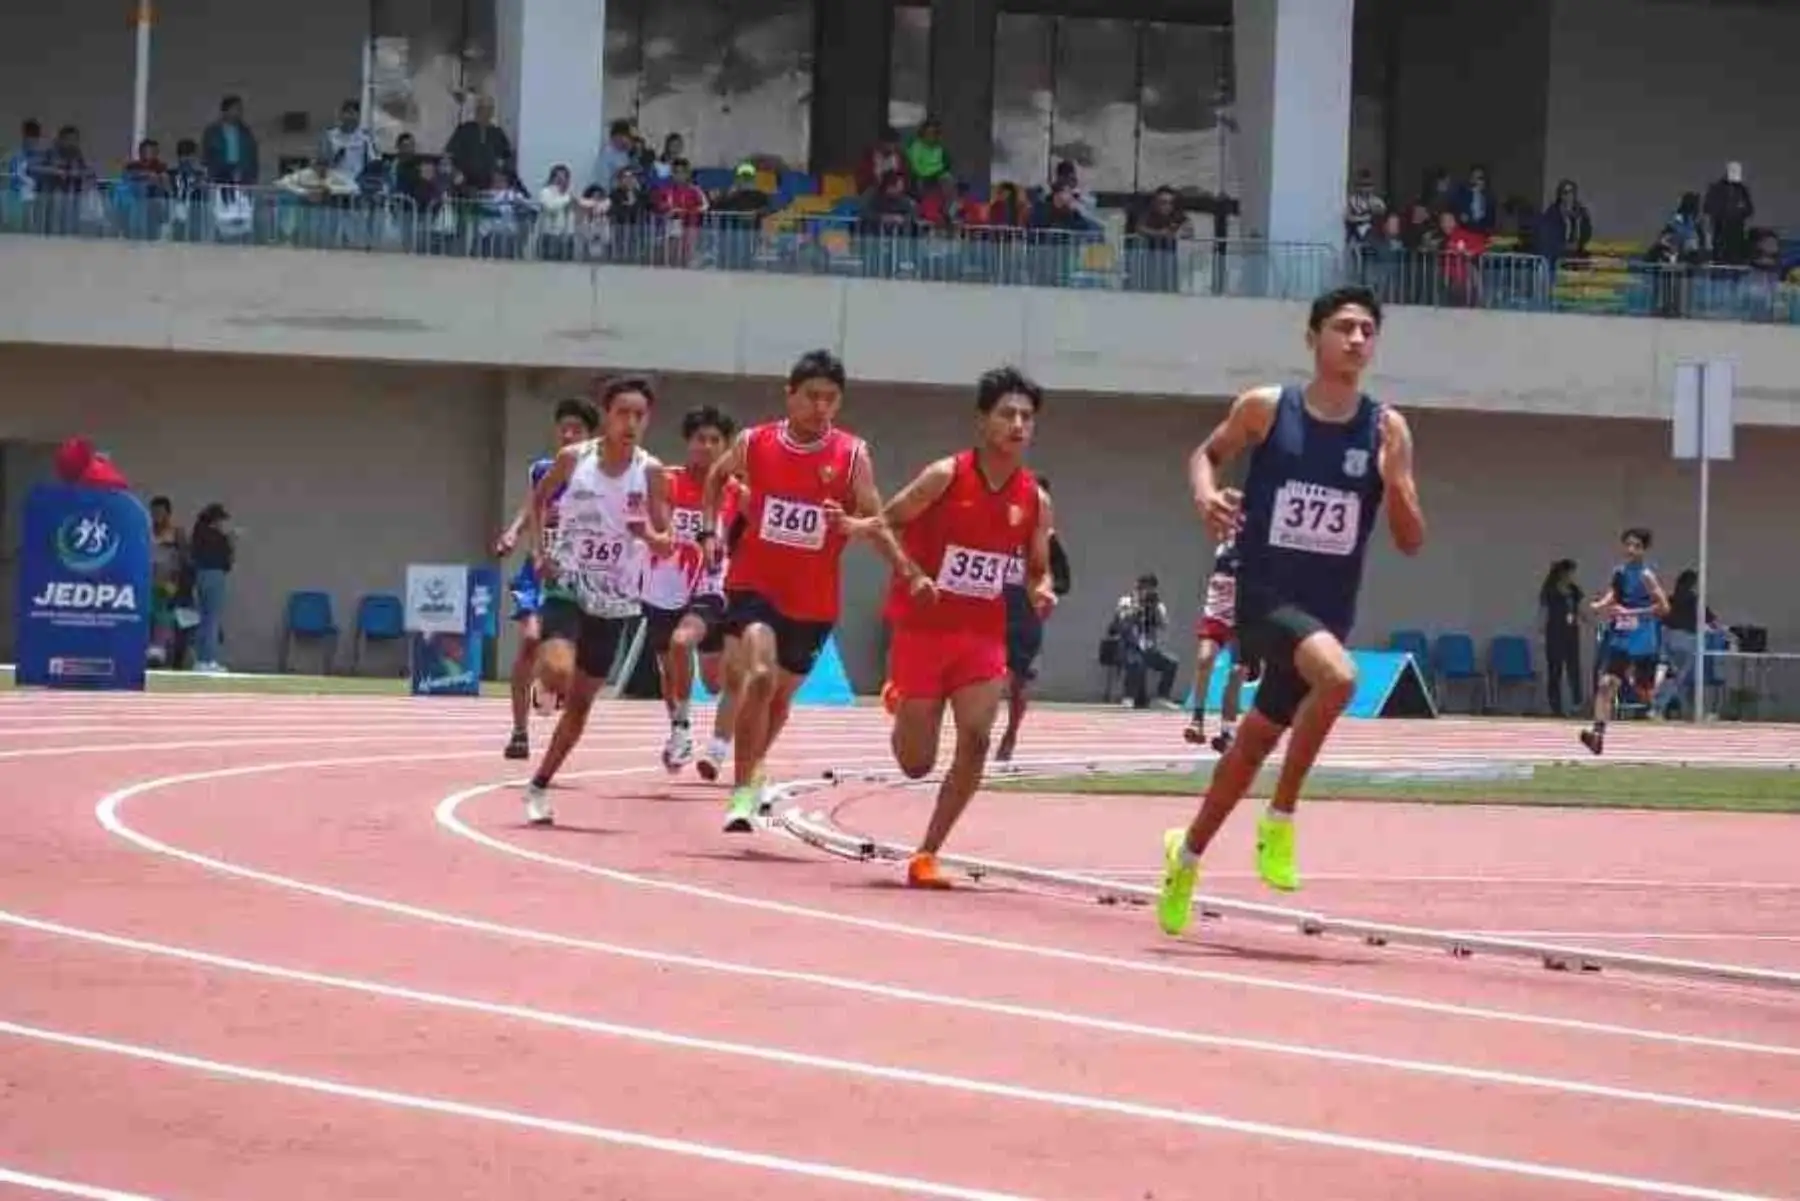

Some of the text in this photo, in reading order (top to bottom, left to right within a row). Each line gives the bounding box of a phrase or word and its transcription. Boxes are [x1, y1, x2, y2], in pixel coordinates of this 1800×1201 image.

[676, 512, 701, 532] 35
[768, 503, 817, 533] 360
[1285, 497, 1346, 533] 373
[581, 539, 622, 563] 369
[951, 552, 1000, 582] 353
[33, 582, 136, 609] JEDPA
